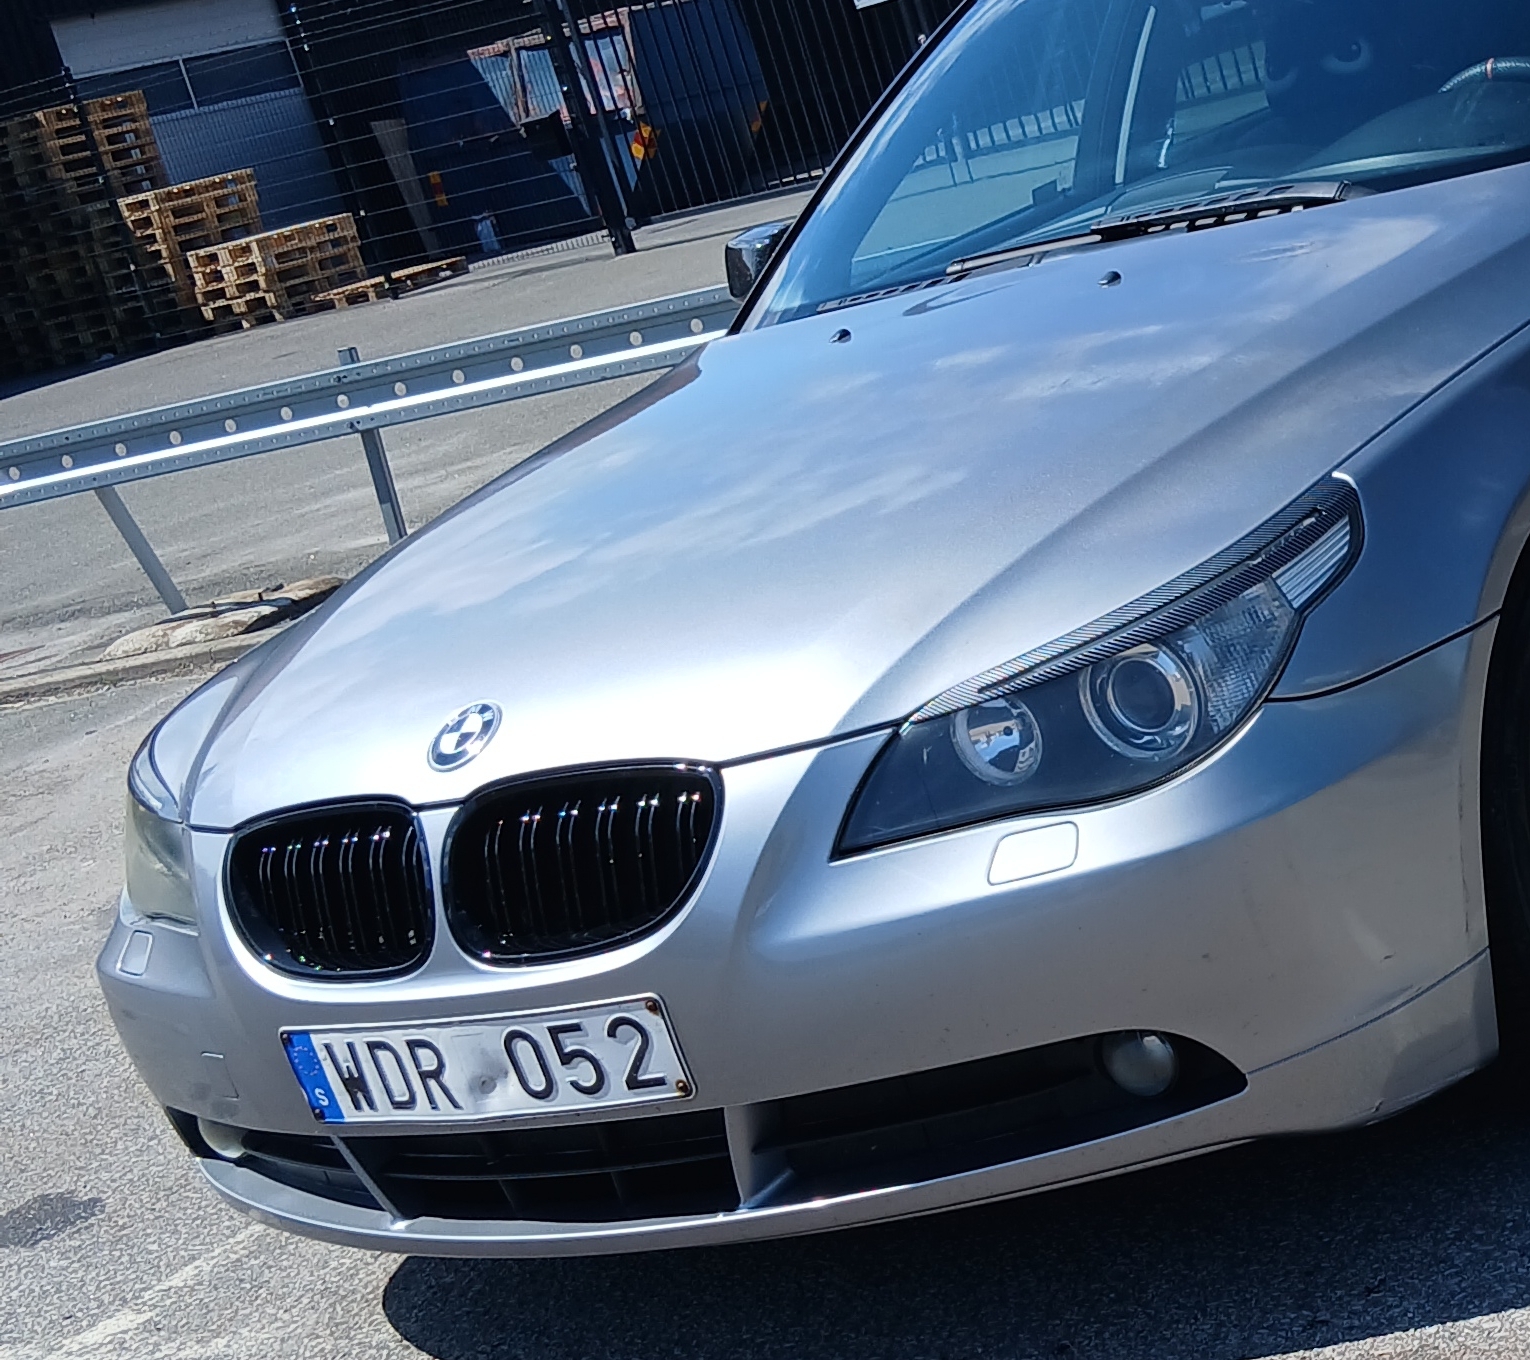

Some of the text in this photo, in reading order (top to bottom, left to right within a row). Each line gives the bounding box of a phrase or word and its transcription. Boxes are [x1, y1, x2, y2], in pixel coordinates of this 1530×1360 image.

[323, 1014, 668, 1112] WDR 052
[314, 1087, 330, 1106] S
